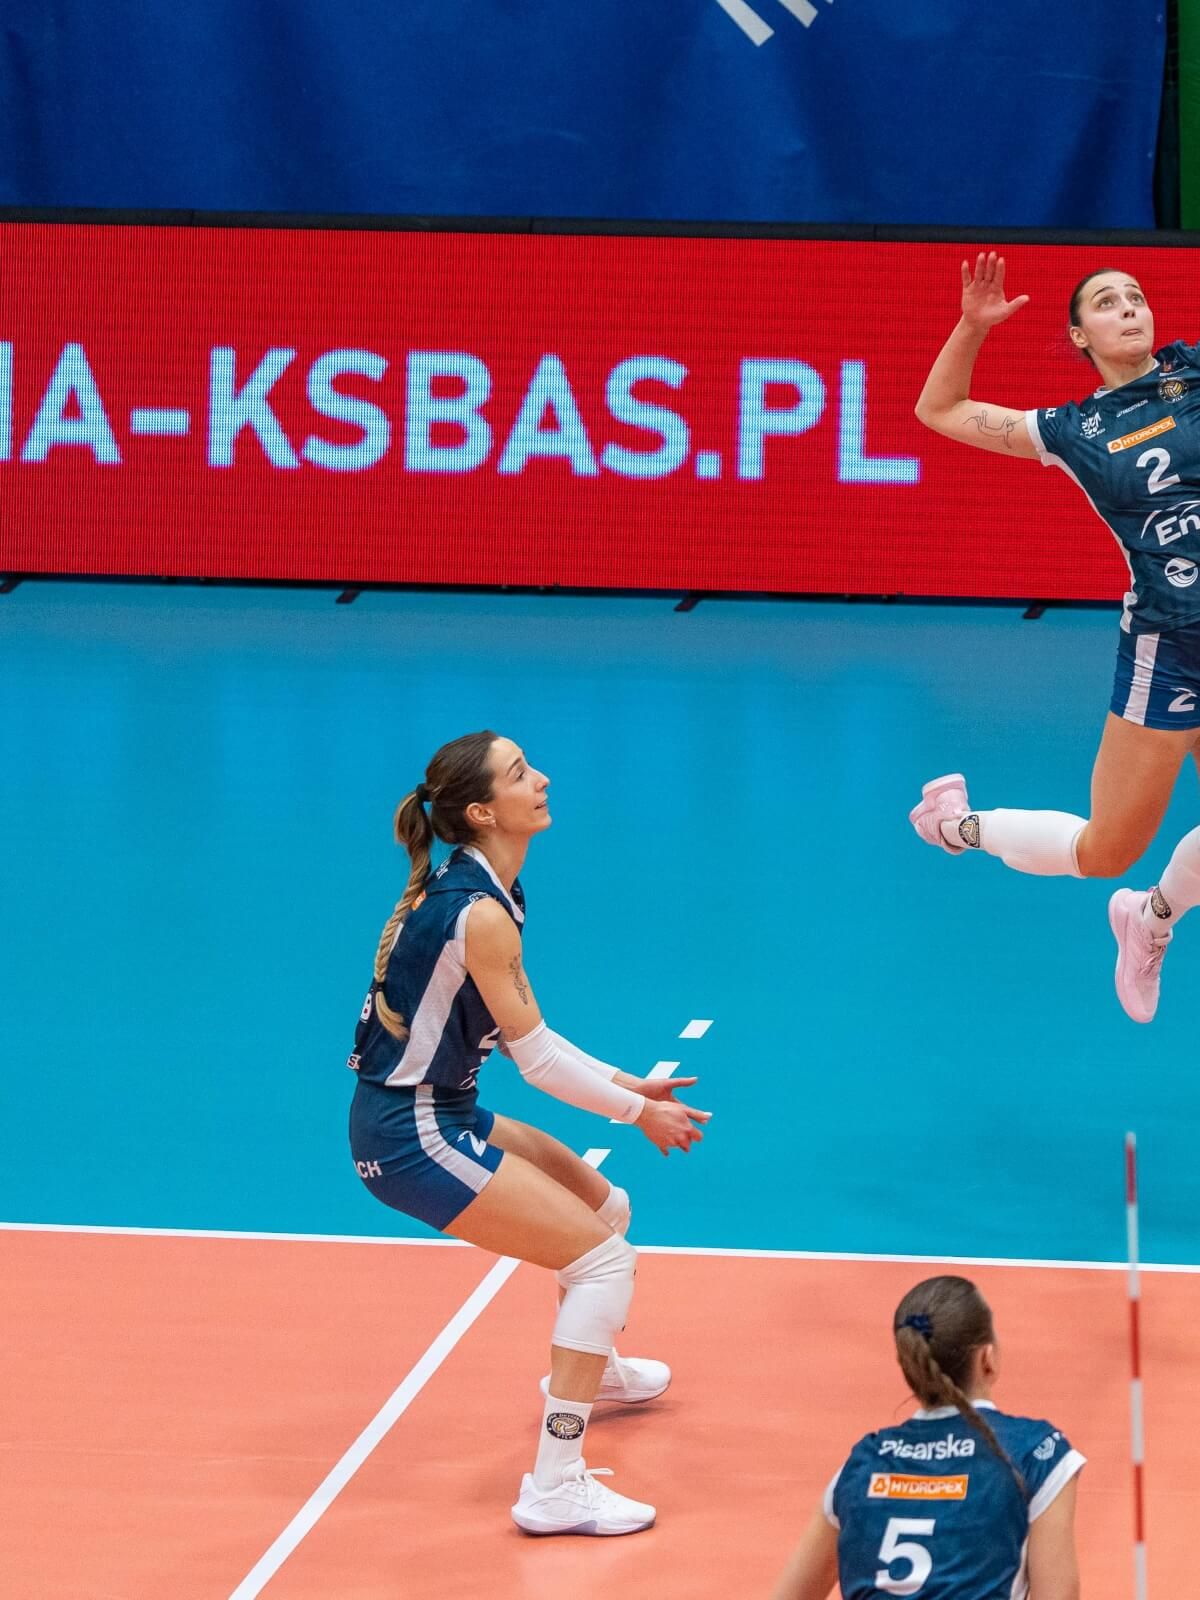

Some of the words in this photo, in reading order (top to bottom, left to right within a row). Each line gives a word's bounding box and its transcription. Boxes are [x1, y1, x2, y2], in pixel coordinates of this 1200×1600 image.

[1123, 418, 1172, 446] HYDROPEX
[1136, 447, 1180, 495] 2
[1168, 687, 1198, 713] 2
[878, 1433, 975, 1460] Pisarska
[890, 1480, 964, 1496] HYDROPEX
[875, 1517, 936, 1596] 5
